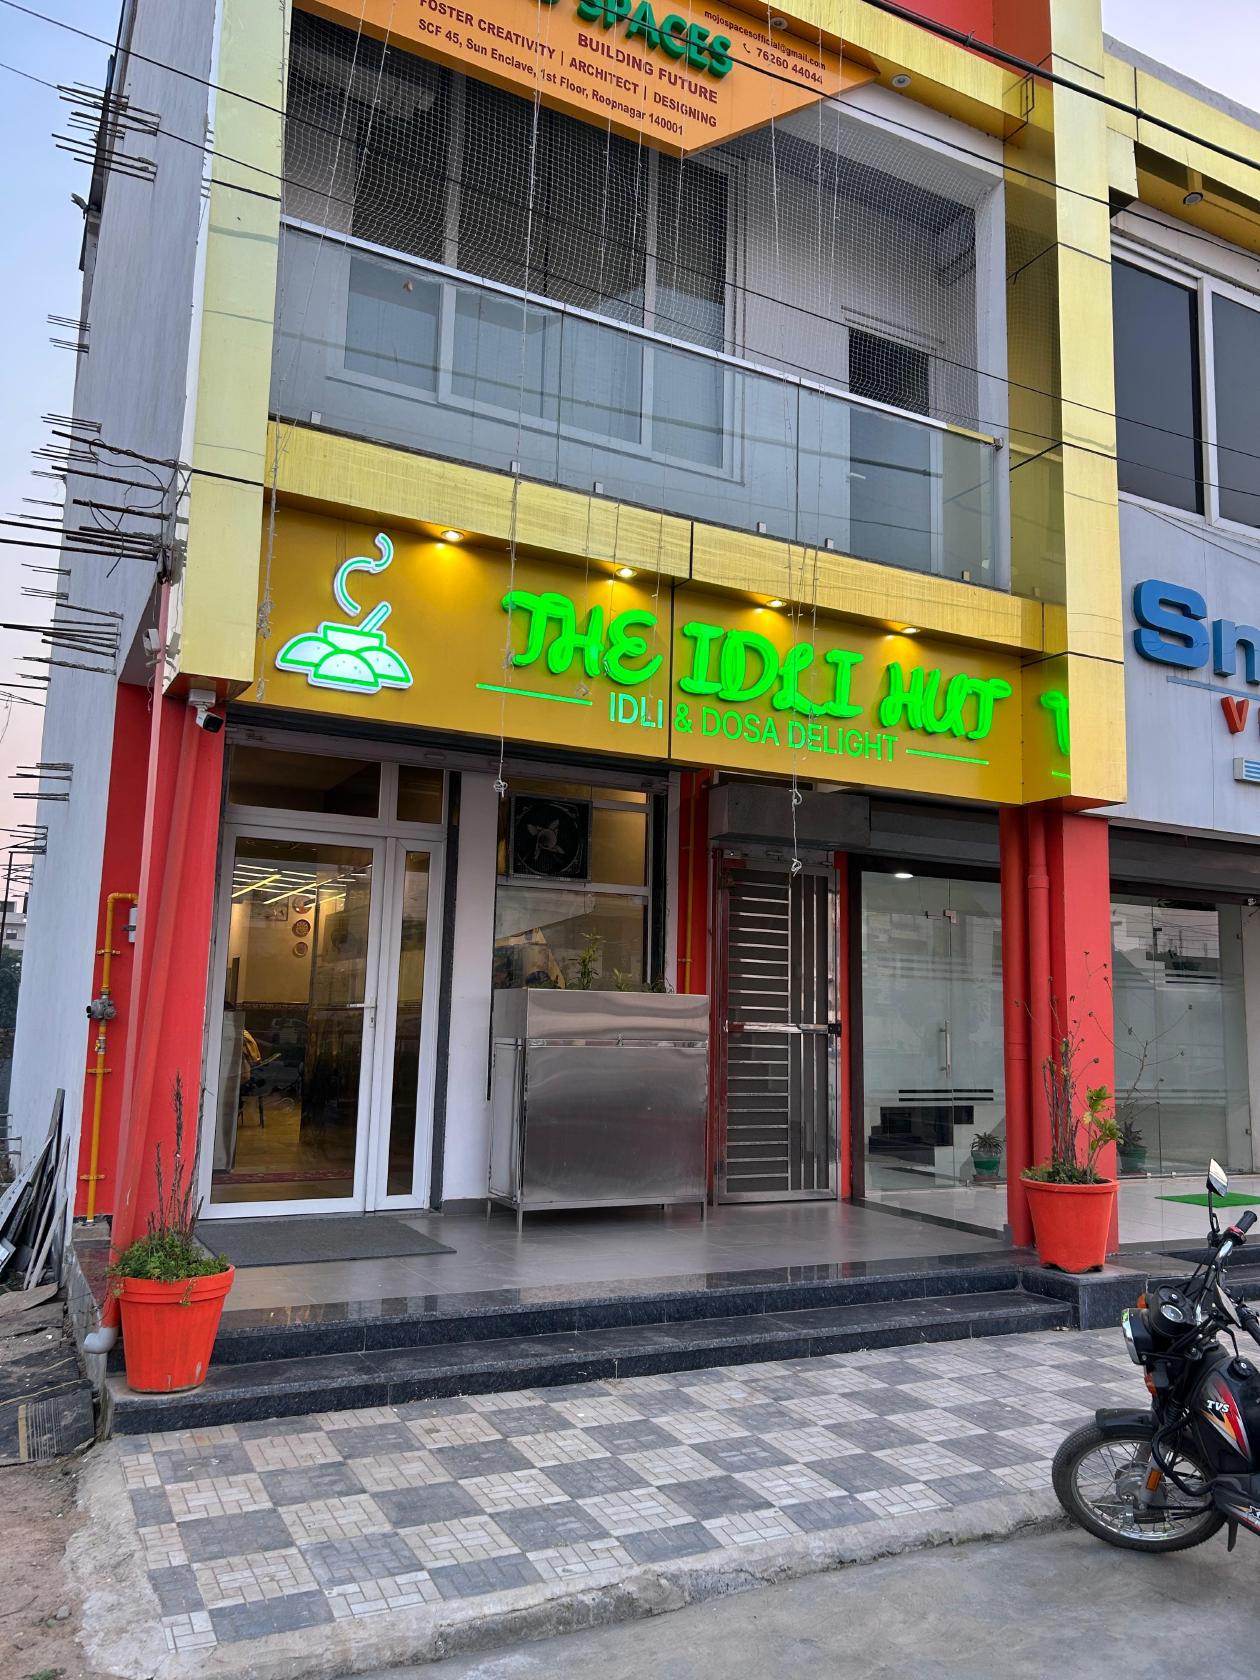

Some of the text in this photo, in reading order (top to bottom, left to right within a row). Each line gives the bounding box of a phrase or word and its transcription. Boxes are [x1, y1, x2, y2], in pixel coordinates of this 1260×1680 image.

[420, 0, 473, 27] FOSTER
[478, 18, 556, 59] CREATIVITY
[570, 57, 639, 94] ARCHITECT
[654, 91, 717, 127] DESIGNING
[578, 33, 718, 104] BUILDING FUTURE
[704, 10, 826, 70] mojospacesofficial@gmail.com
[756, 48, 823, 84] 76260 44044
[418, 19, 683, 135] SCF 45, Sun Enclave, 1st Floor, Roopnagar 140001
[502, 590, 1013, 740] THE IDLI HUT
[609, 691, 899, 762] IDLI & DOSA DELIGHT
[1206, 1399, 1230, 1413] TVS
